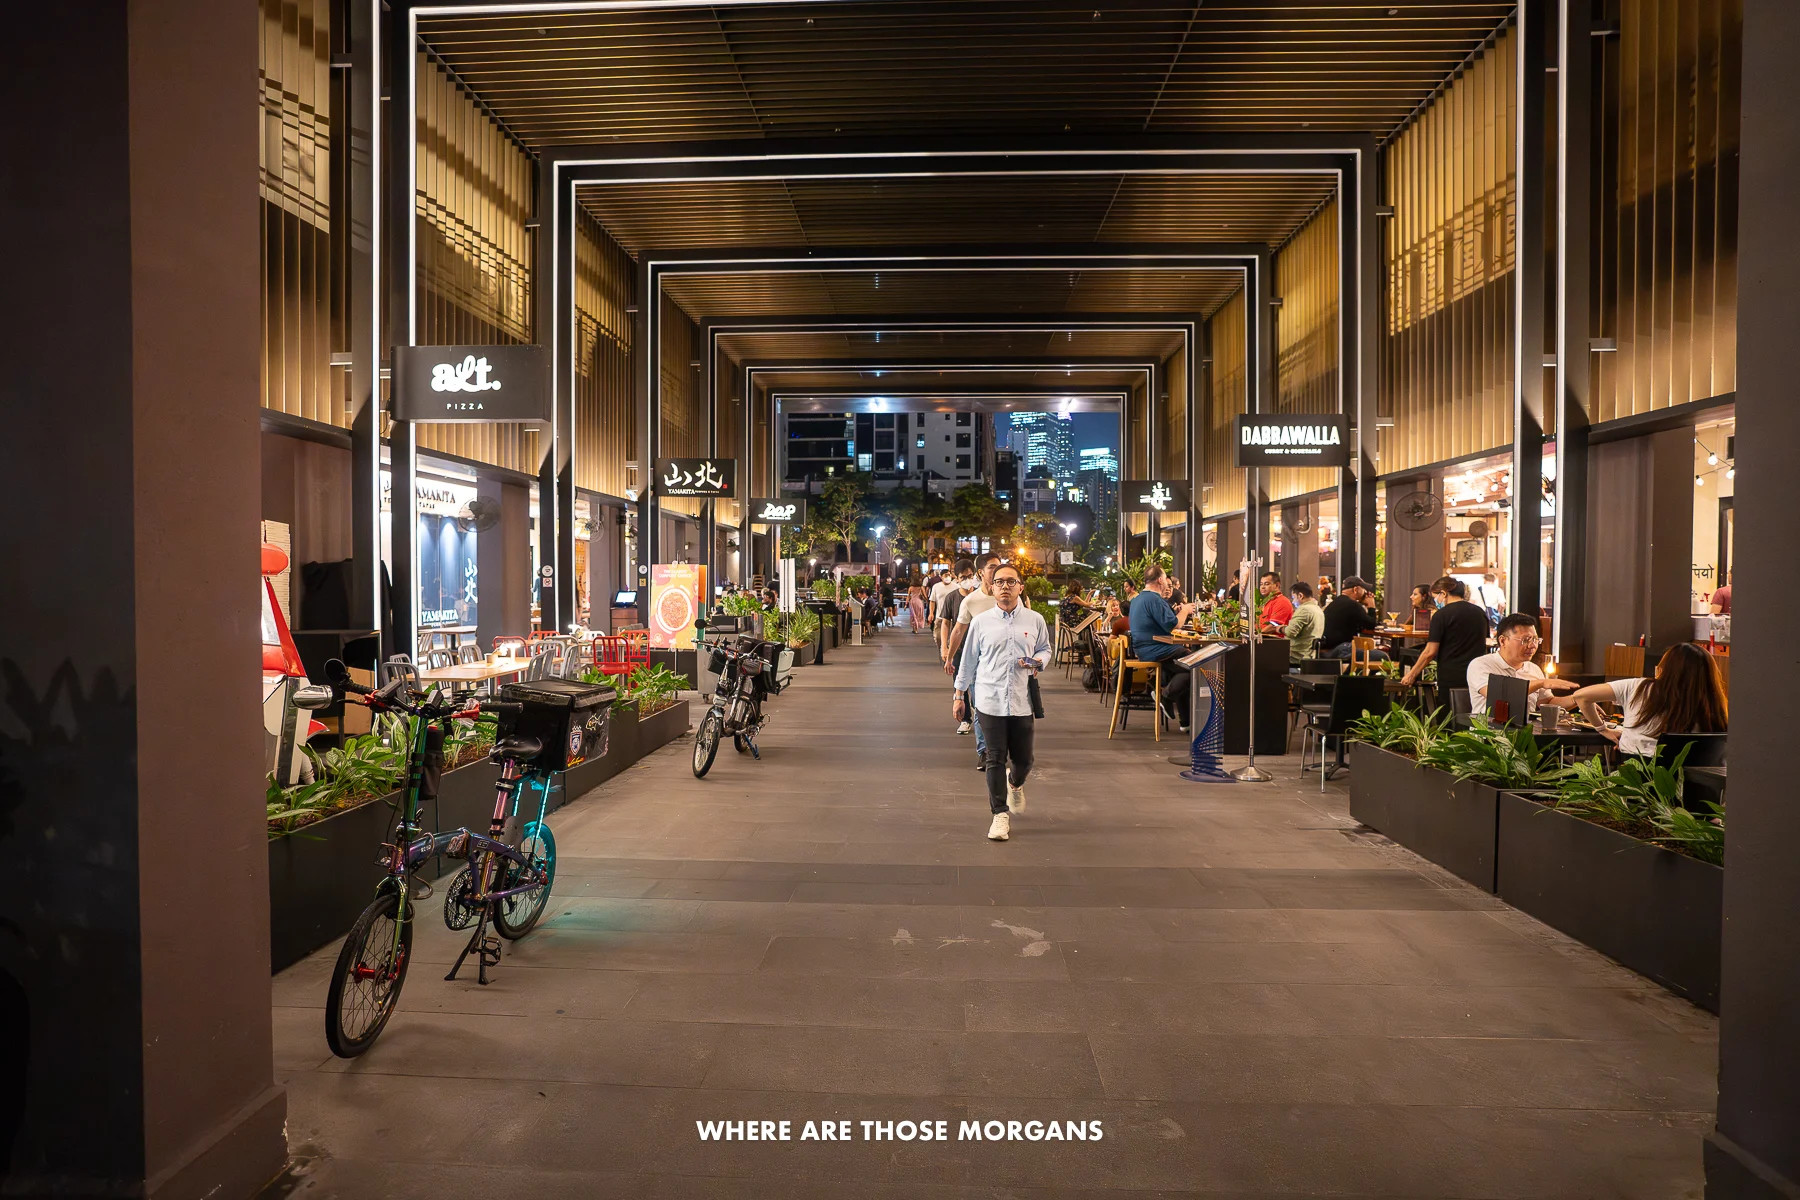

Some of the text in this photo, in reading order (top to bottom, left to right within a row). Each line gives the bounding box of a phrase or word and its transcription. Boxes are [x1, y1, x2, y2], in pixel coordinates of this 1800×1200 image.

[1242, 426, 1340, 445] DABBAWALLA
[663, 460, 723, 489] 山北
[416, 486, 456, 504] AMAKITA
